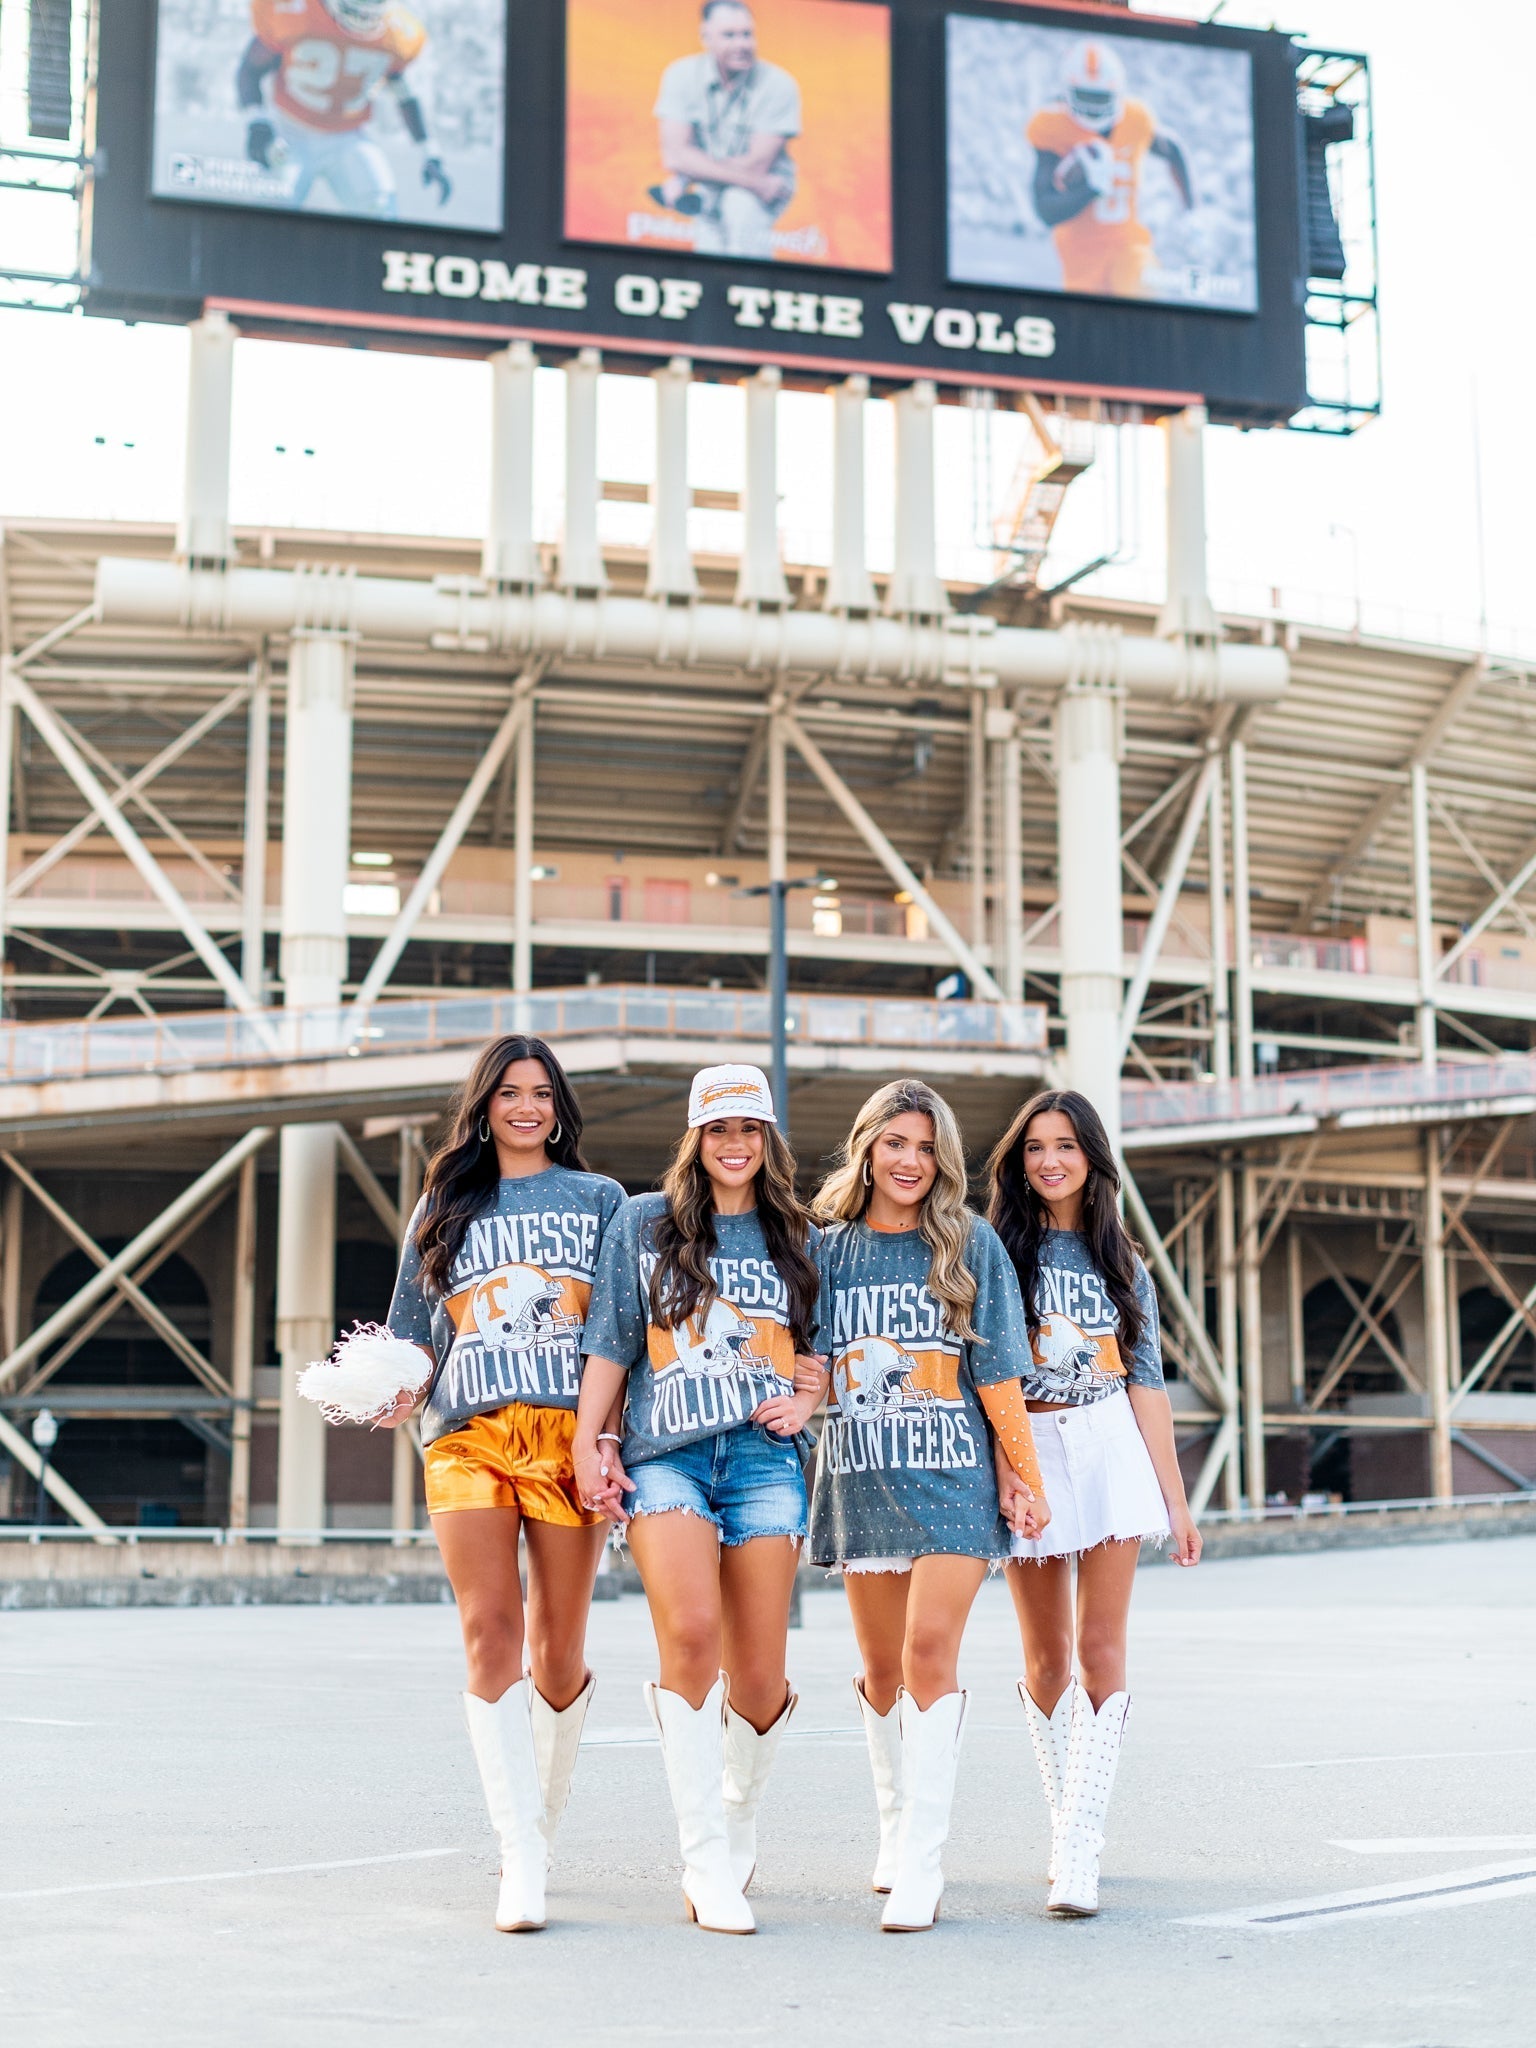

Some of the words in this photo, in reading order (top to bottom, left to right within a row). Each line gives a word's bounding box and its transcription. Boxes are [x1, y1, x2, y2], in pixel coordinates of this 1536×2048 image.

[382, 250, 588, 310] HOME
[614, 274, 703, 320] OF
[727, 284, 864, 338] THE
[886, 302, 1056, 358] VOLS
[449, 1211, 599, 1284] ENNESSE
[449, 1345, 582, 1409] VOLUNTE
